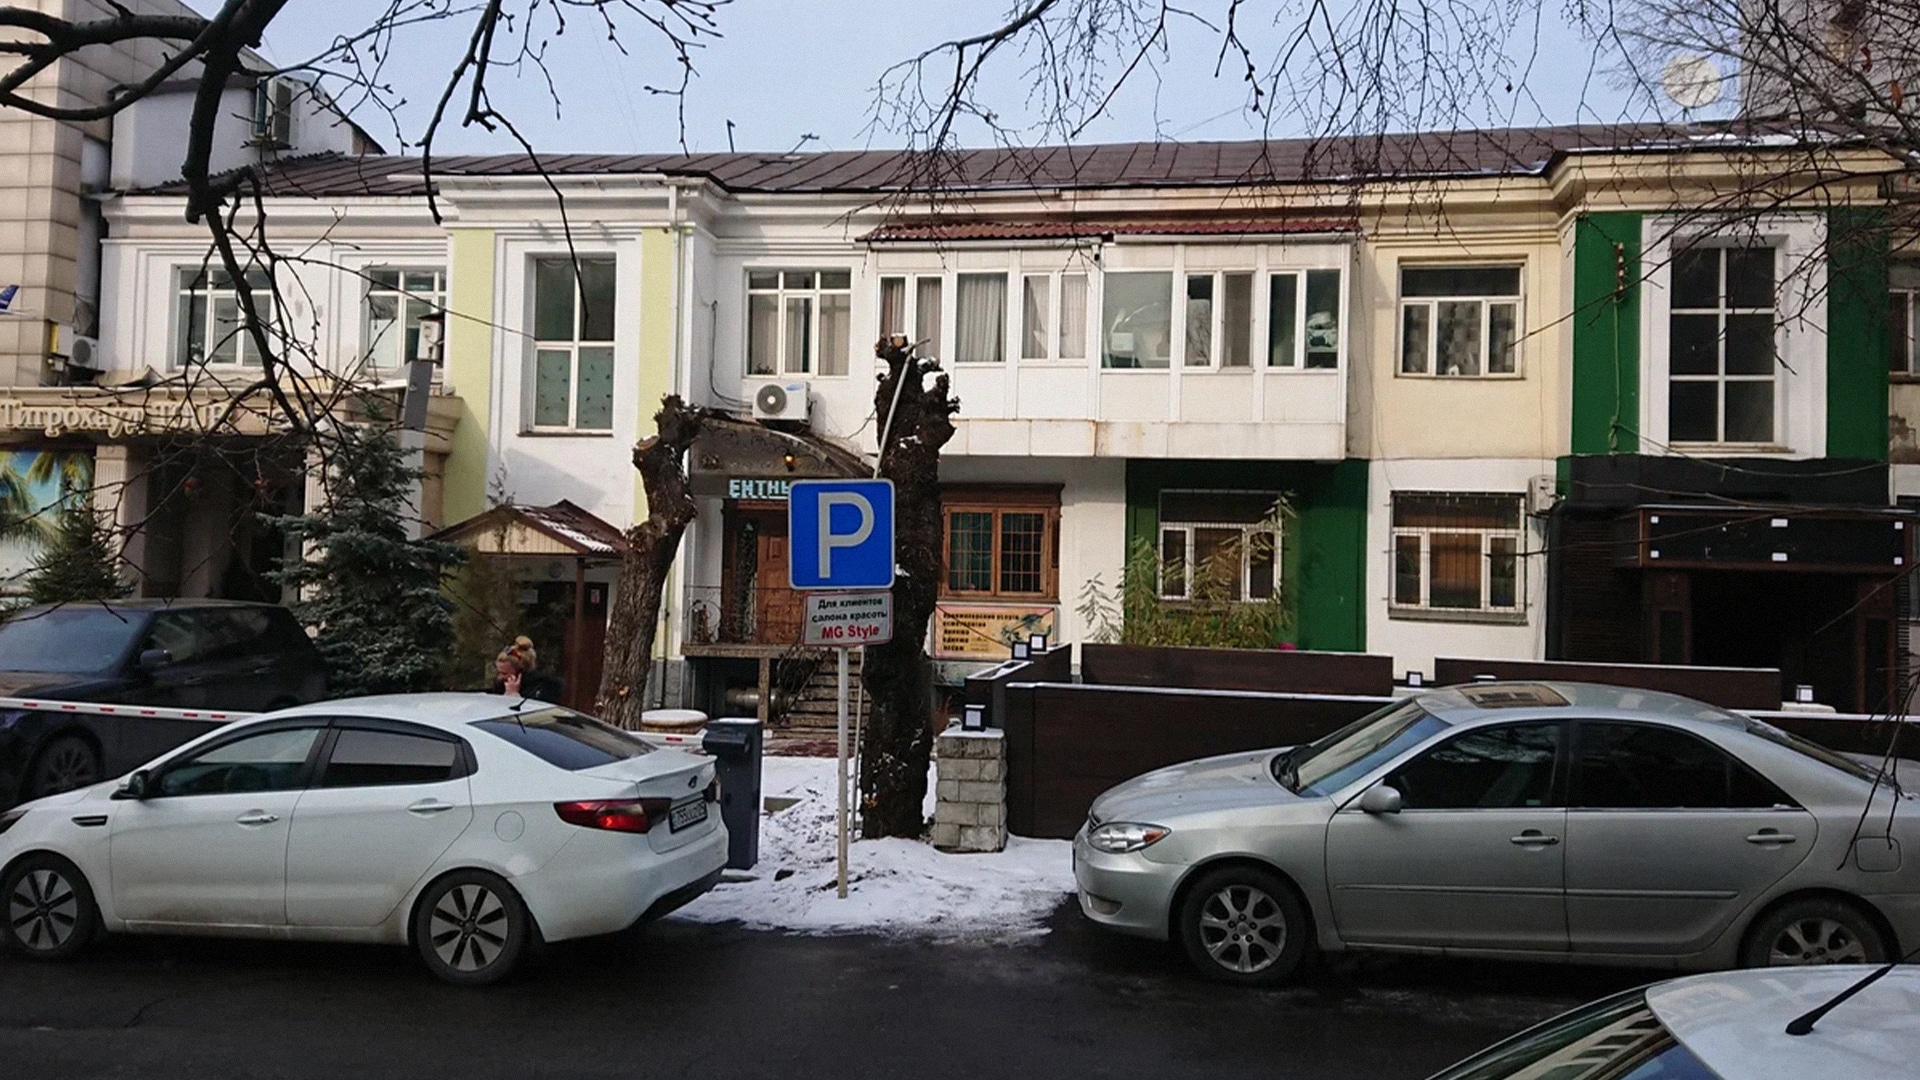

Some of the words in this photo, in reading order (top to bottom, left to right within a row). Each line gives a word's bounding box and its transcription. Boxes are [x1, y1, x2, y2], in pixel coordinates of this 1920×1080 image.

[818, 492, 875, 579] P
[818, 599, 837, 610] Для
[840, 598, 883, 607] клиентов
[812, 612, 848, 623] салона
[850, 611, 888, 621] красоты
[822, 625, 844, 639] MG
[847, 624, 880, 639] Style
